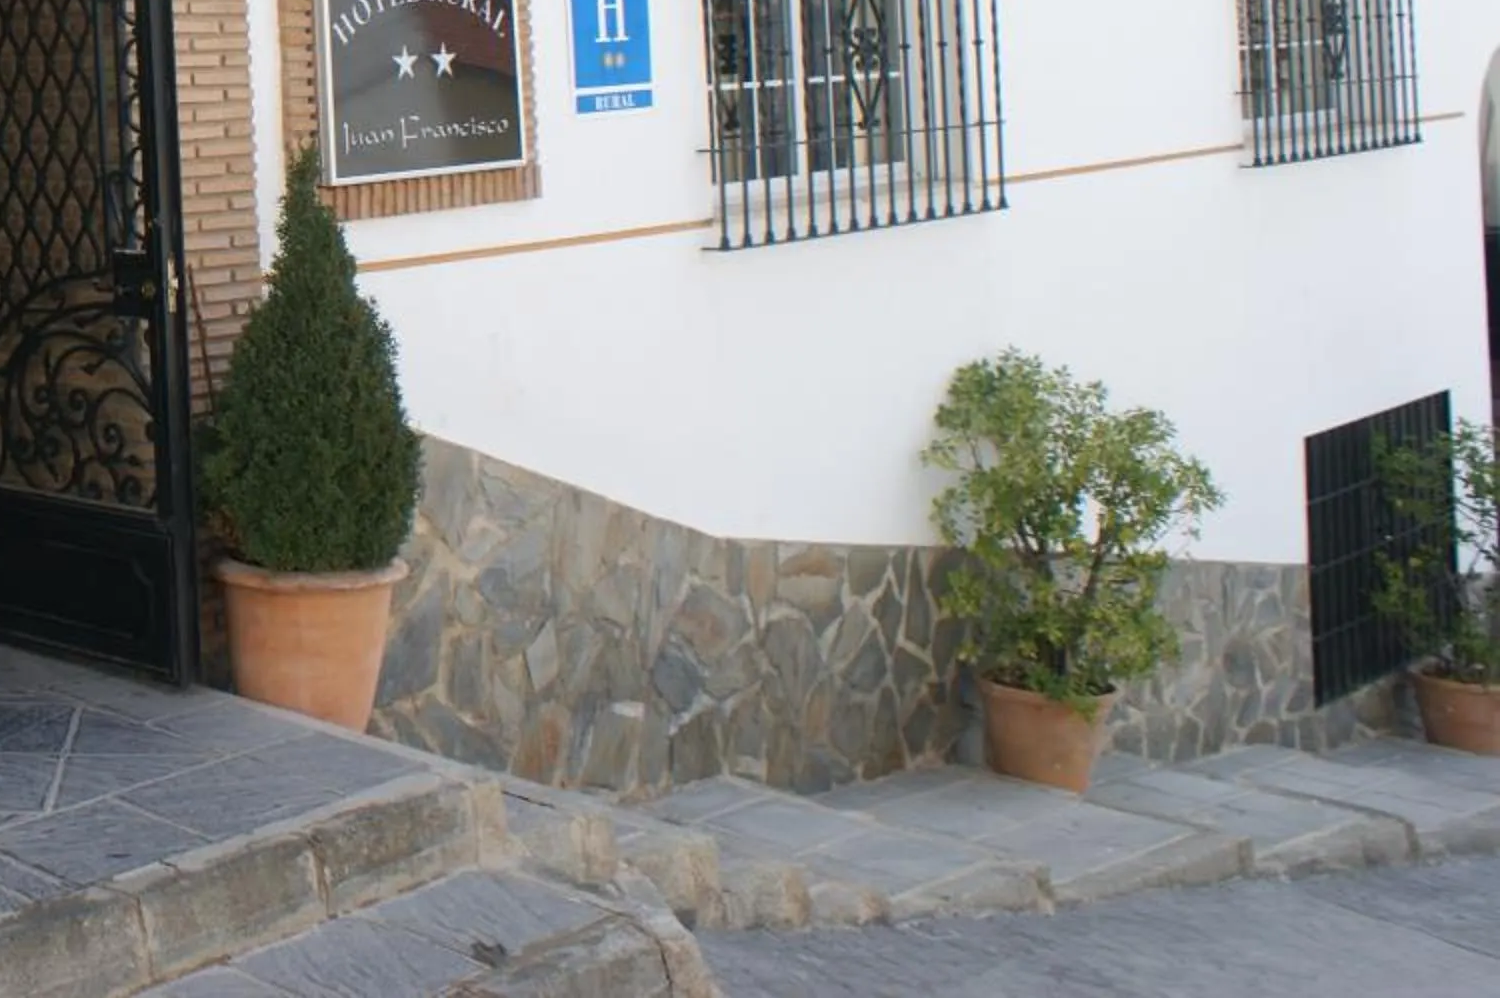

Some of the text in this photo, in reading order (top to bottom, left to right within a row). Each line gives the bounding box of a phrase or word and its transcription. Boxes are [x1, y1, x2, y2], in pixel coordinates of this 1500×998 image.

[595, 93, 637, 111] RURAL
[343, 115, 509, 154] Juan Francisco
